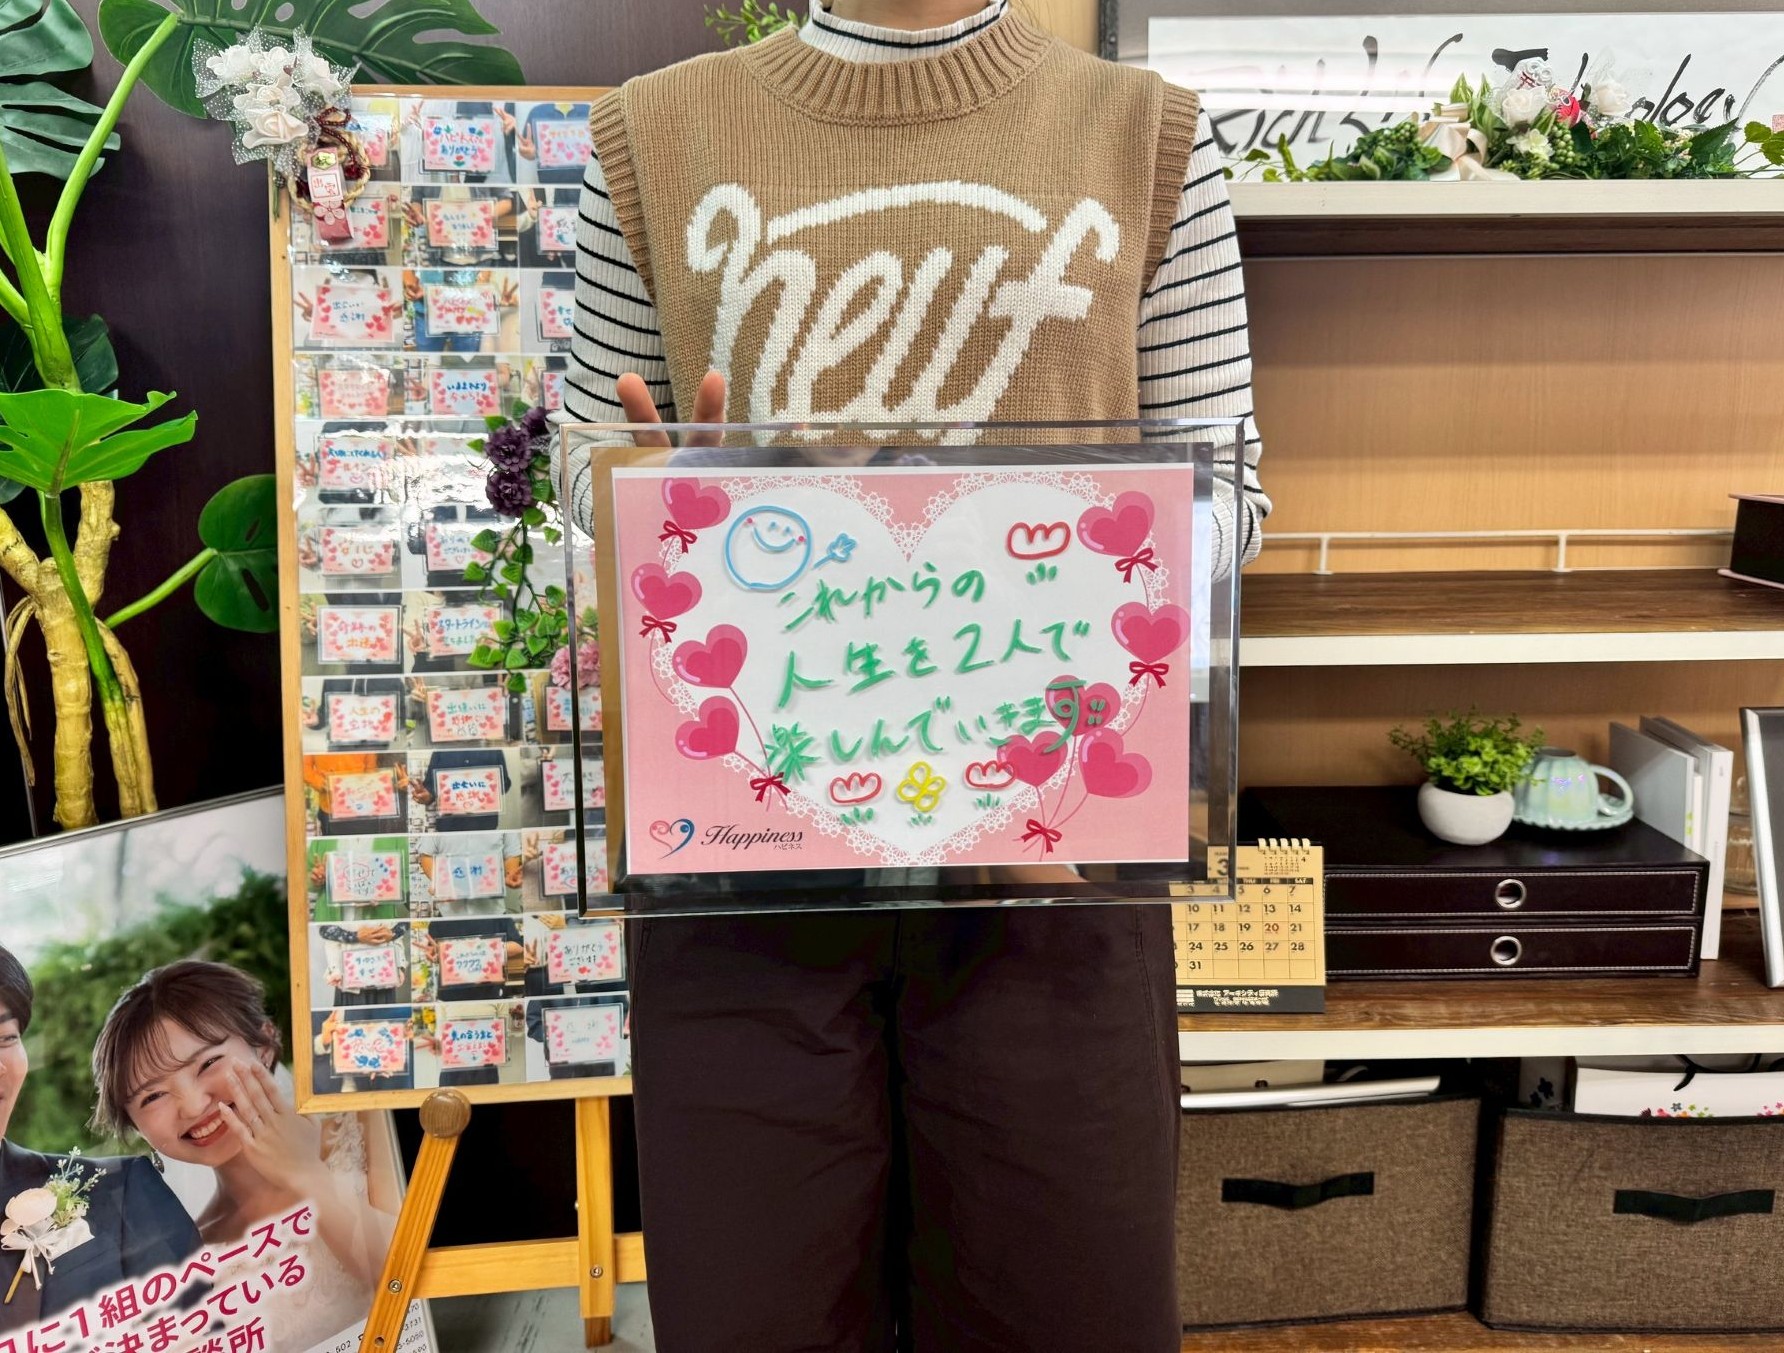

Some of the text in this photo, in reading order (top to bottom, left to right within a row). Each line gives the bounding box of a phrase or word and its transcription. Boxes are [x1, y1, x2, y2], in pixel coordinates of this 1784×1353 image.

[777, 562, 985, 630] これからの
[777, 619, 1090, 708] 人生を2人で
[701, 824, 803, 850] Happiness
[453, 866, 482, 878] 感謝
[1238, 886, 1245, 894] 5
[1264, 886, 1271, 894] 6
[1188, 904, 1301, 912] 10 11 12 13 14
[1188, 923, 1302, 931] 17 18 19 20 21
[564, 944, 604, 954] ありがとう
[1188, 942, 1305, 950] 24 25 26 27 28
[1189, 961, 1201, 969] 31
